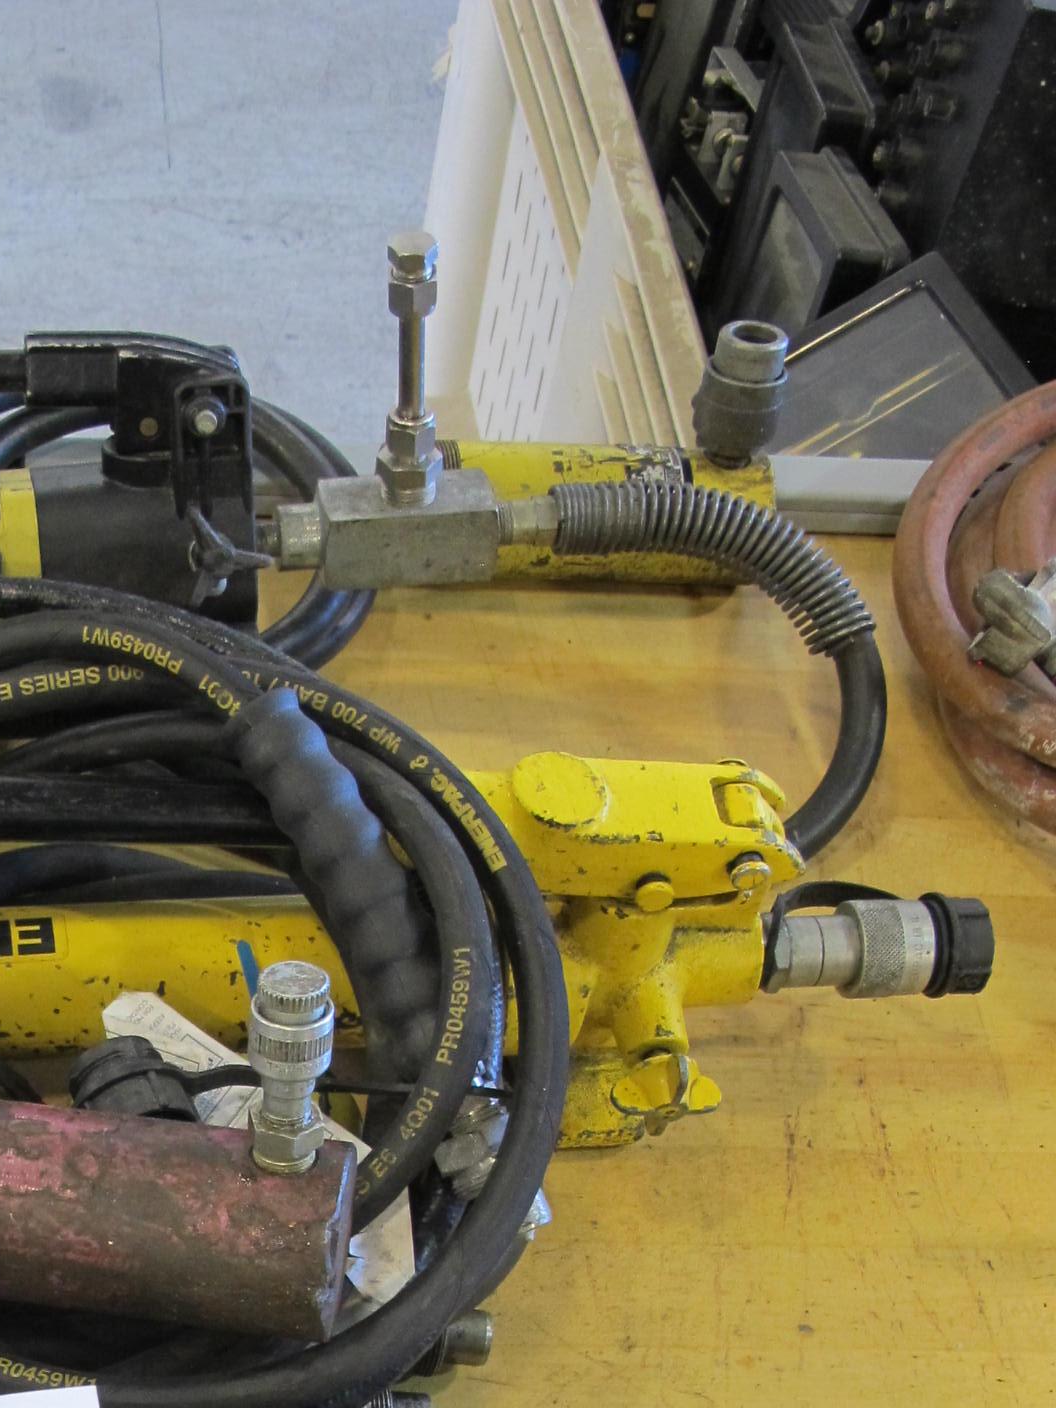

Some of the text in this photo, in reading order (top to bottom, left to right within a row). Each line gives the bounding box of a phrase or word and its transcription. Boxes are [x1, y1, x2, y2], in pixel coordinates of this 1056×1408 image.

[82, 625, 184, 675] PR0459W1
[20, 665, 100, 696] SERIES
[331, 701, 368, 730] 700
[368, 726, 402, 754] WP
[368, 947, 471, 1179] E6 4Q01 PR0459W1
